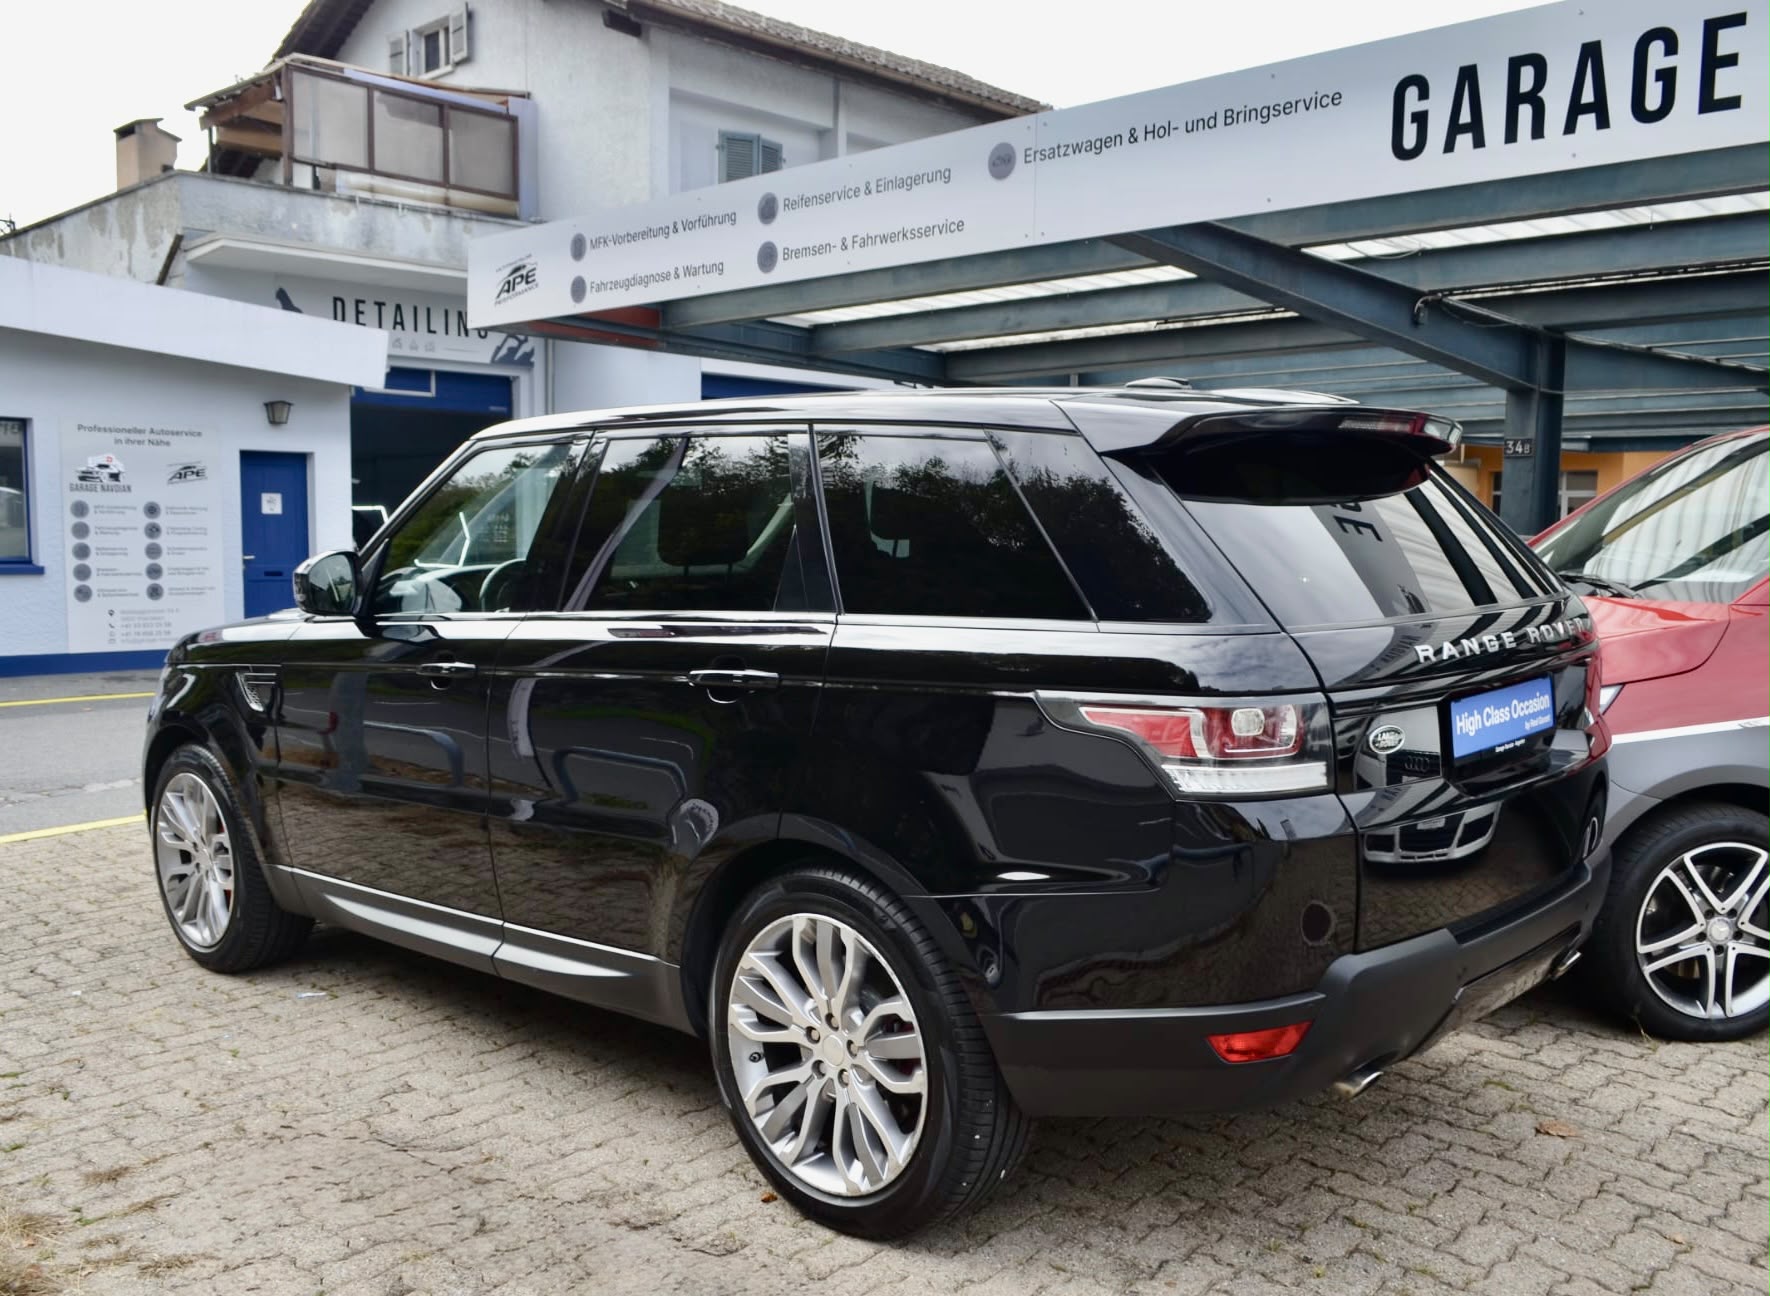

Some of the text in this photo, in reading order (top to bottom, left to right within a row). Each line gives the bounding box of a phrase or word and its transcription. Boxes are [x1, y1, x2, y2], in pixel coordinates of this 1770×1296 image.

[1390, 11, 1748, 161] GARAGE
[1023, 89, 1343, 165] Ersatzwagen & Hol- und Bringservice
[783, 167, 952, 212] Reifenservice & Einlagerung
[590, 211, 737, 251] MFK-Vorbereitung & Vorführung
[782, 218, 965, 261] Bremsen- & Fahrwerksservice
[496, 267, 536, 299] APE
[590, 261, 724, 293] Fahrzeugdiagnose & Wartung
[77, 424, 203, 438] Professioneller Autoservice
[69, 482, 98, 493] GARAGE
[167, 468, 206, 481] APE
[1414, 631, 1518, 664] RANGE
[1455, 691, 1550, 737] High Class Occasion
